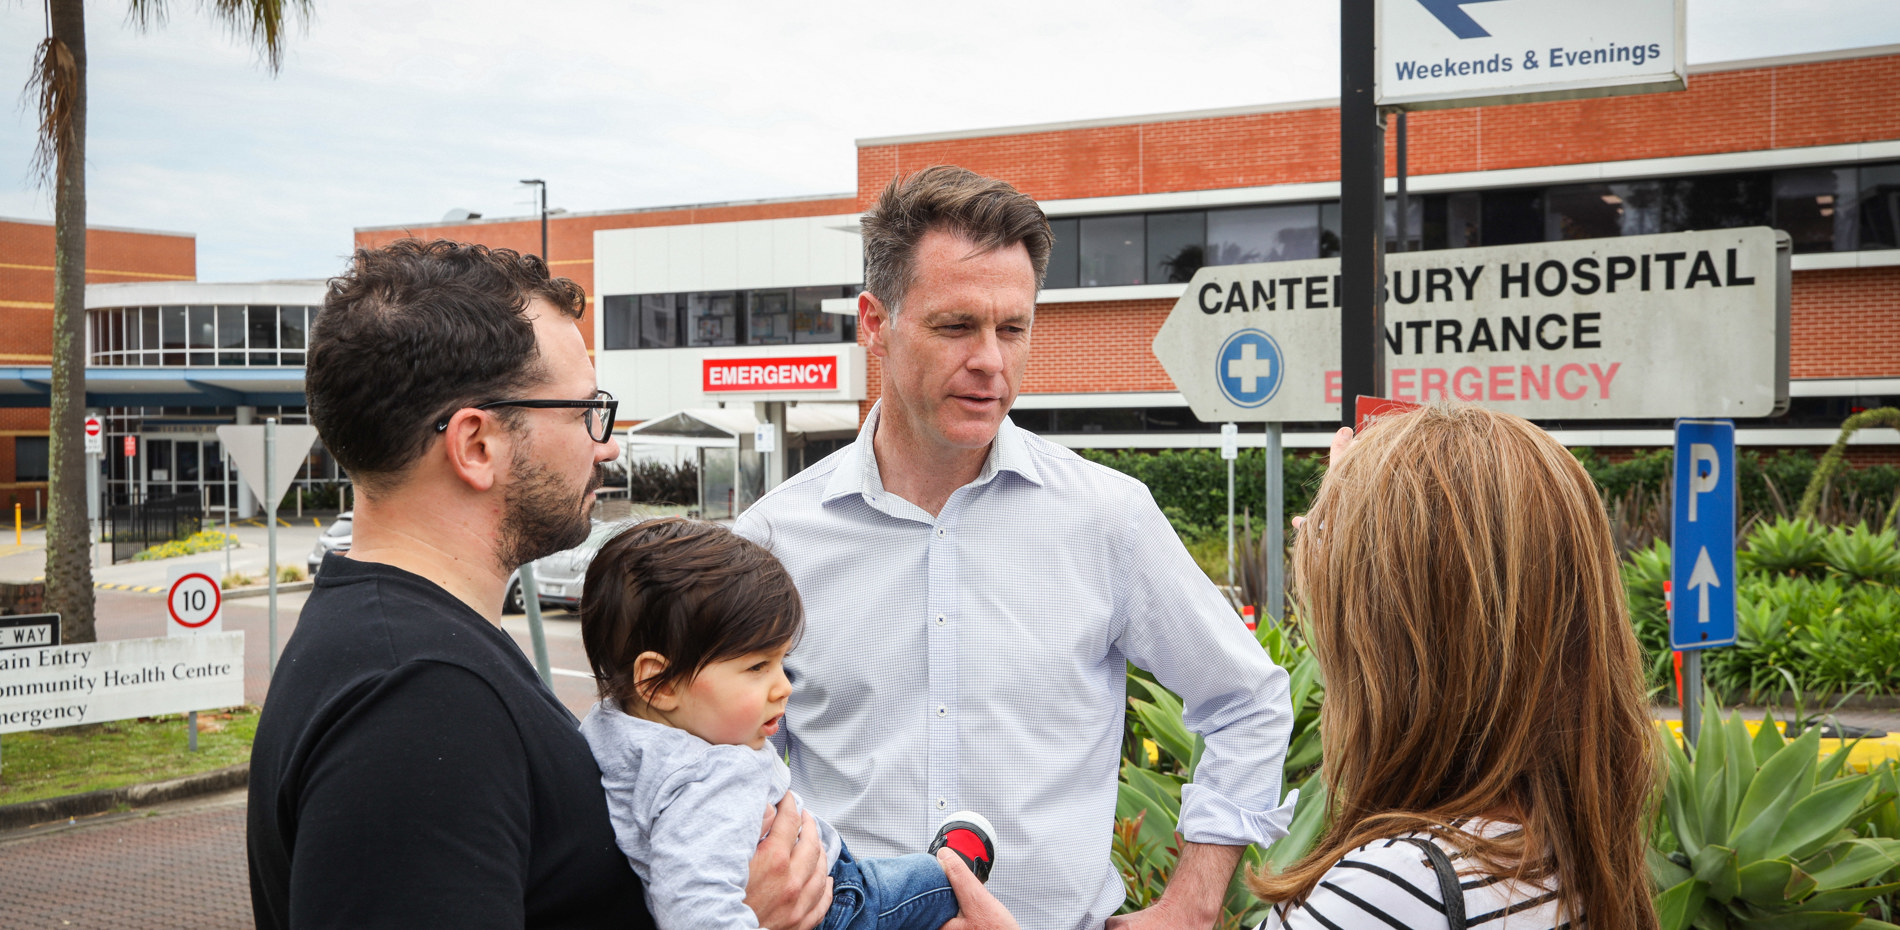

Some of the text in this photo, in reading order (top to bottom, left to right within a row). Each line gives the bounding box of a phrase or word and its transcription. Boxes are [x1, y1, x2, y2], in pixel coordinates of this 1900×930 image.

[1396, 43, 1660, 80] Weekends & Evenings
[1198, 248, 1755, 314] CANTEURY HOSPITAL
[1385, 312, 1602, 355] NTRANCE
[709, 364, 832, 385] EMERGENCY
[1325, 362, 1622, 404] EERGENCY
[1688, 443, 1720, 522] P
[182, 589, 206, 611] 10
[14, 627, 46, 643] WAY
[39, 650, 91, 669] Entry
[104, 666, 165, 687] Health
[172, 662, 231, 680] Centre
